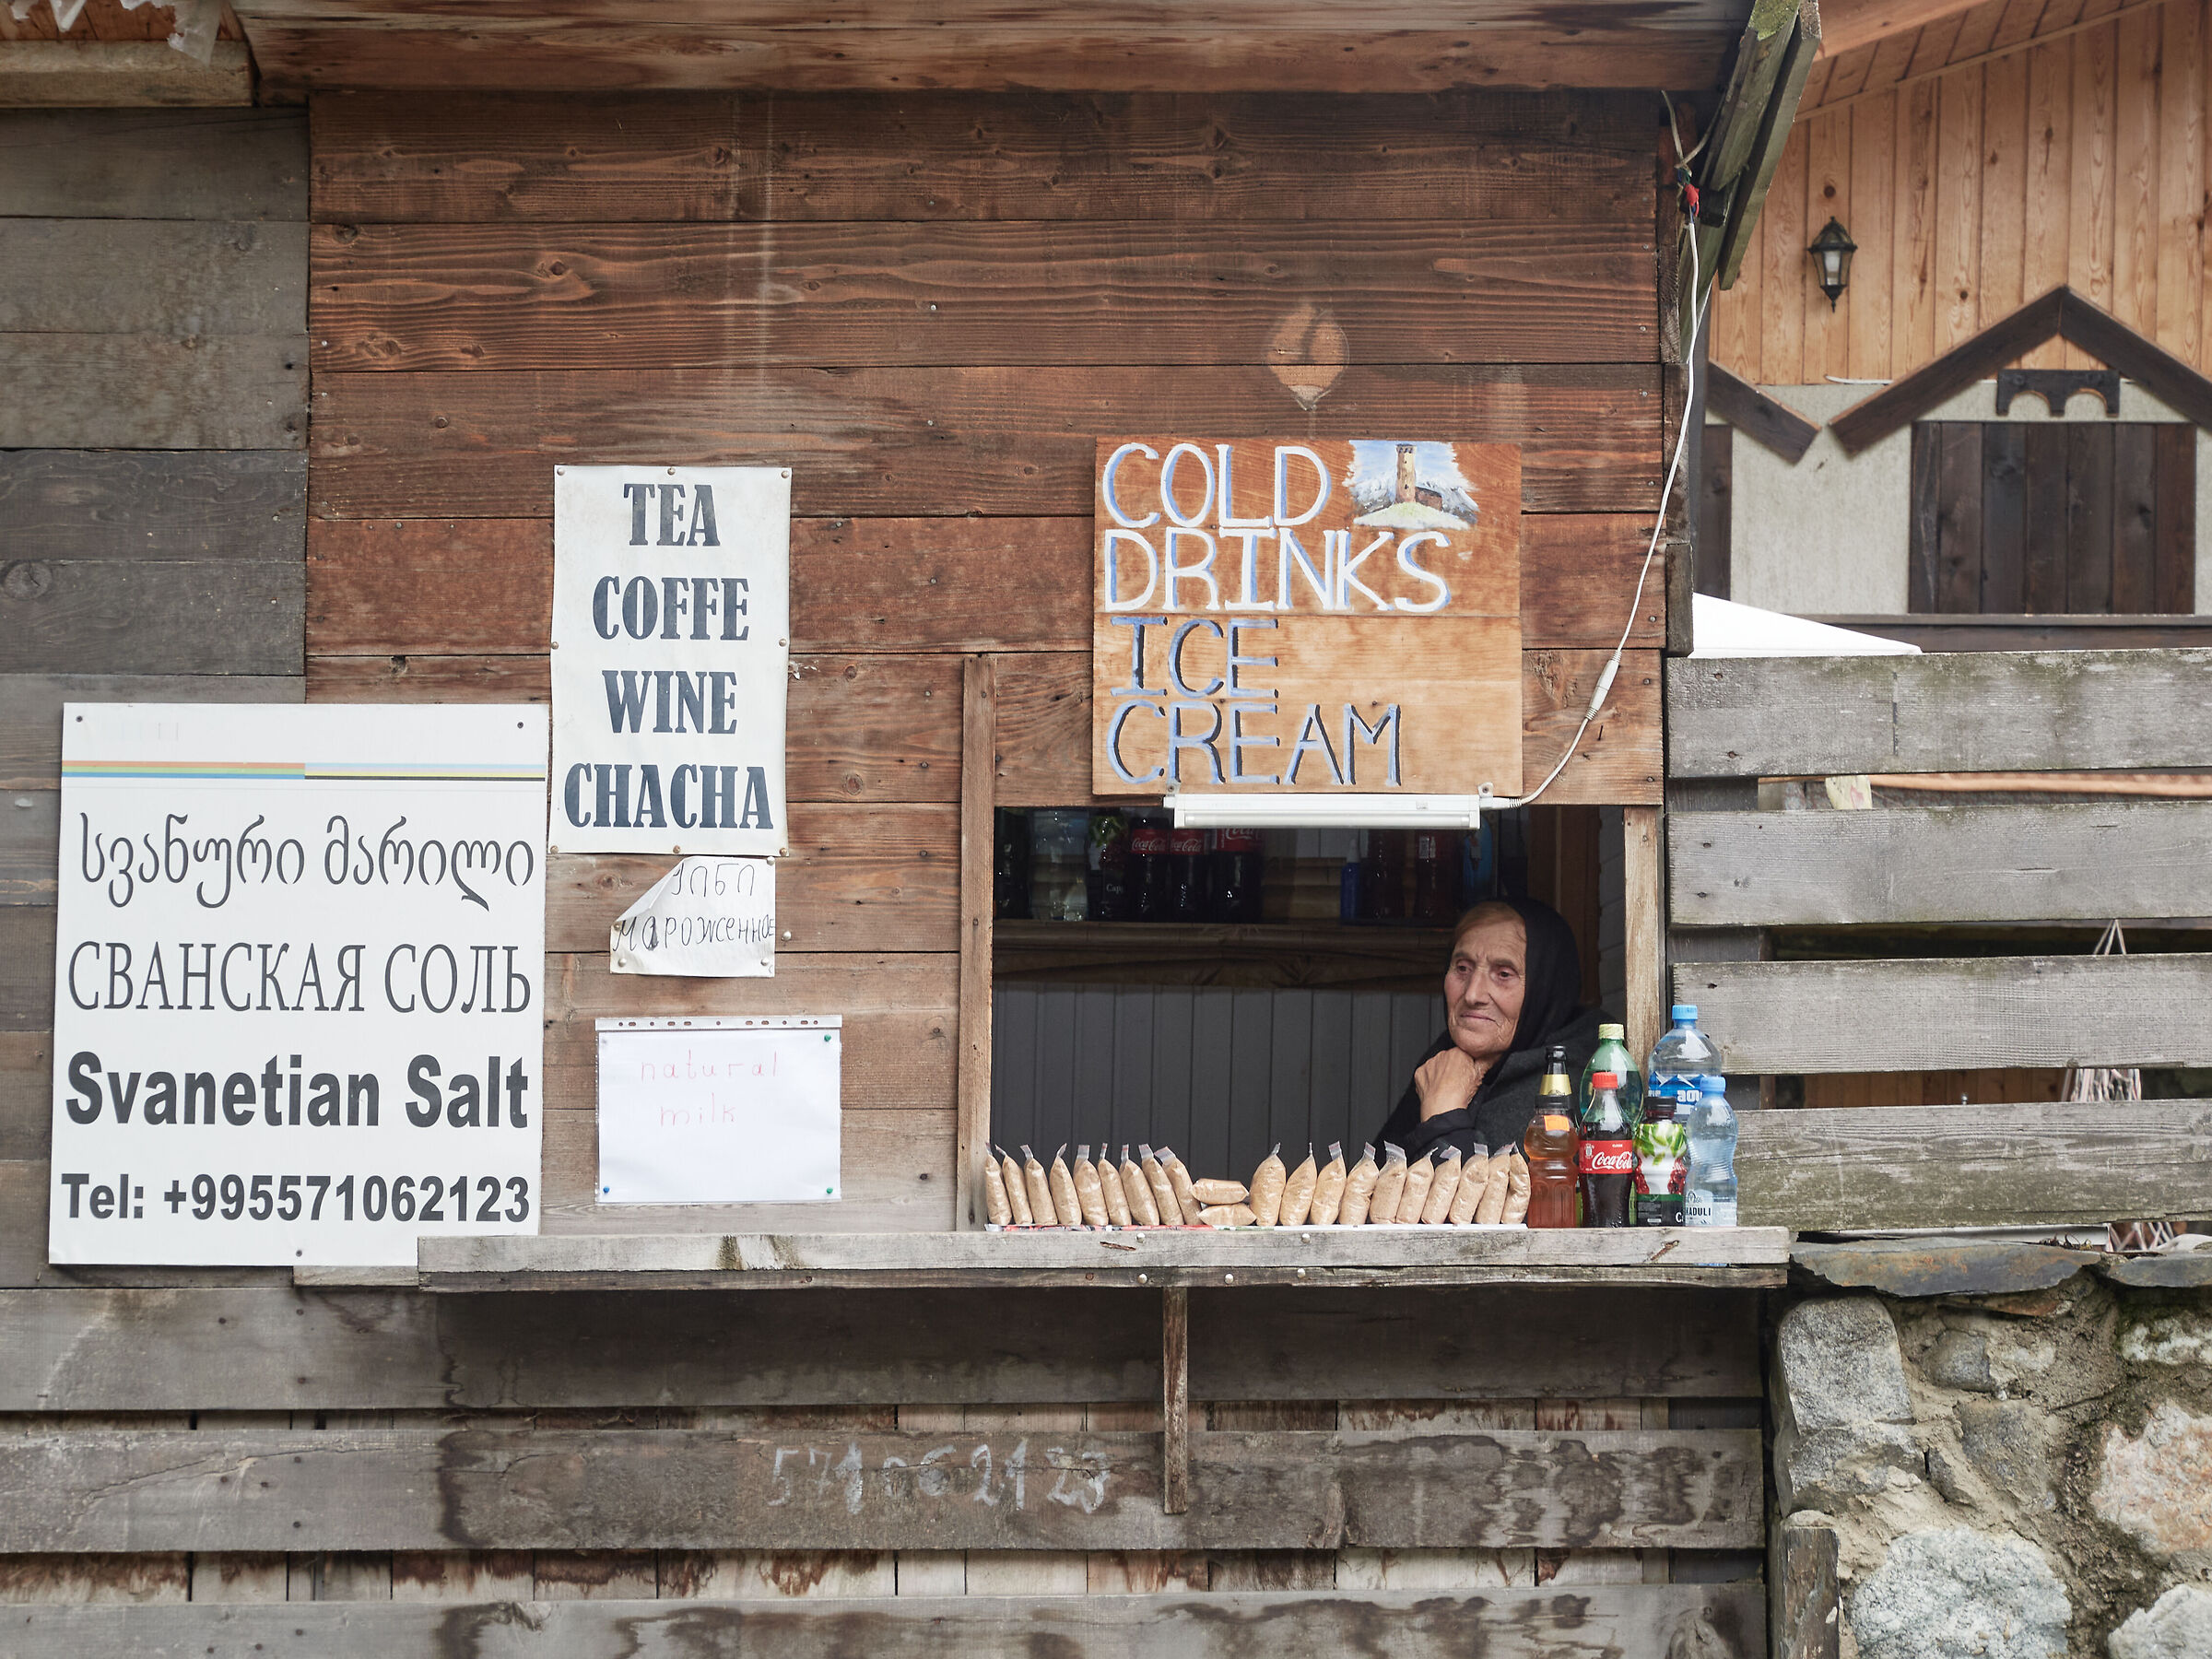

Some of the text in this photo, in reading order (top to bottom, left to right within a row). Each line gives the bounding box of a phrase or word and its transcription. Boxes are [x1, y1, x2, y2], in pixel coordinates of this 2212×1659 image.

[623, 483, 721, 547] TEA
[1102, 441, 1332, 529] COLD
[1104, 526, 1453, 613] DRINKS
[592, 575, 750, 641] COFFE
[1110, 616, 1279, 699] ICE
[601, 670, 737, 735] WINE
[1106, 700, 1402, 786] CREAM
[564, 762, 774, 830] CHACHA
[79, 811, 535, 912] სვანური მარილი
[68, 941, 532, 1014] СВАНСКАЯ СОЛЬ
[65, 1051, 528, 1128] Svanetian Salt
[641, 1049, 779, 1083] natural
[660, 1091, 737, 1128] milk
[61, 1172, 530, 1222] Tel: +995571062123
